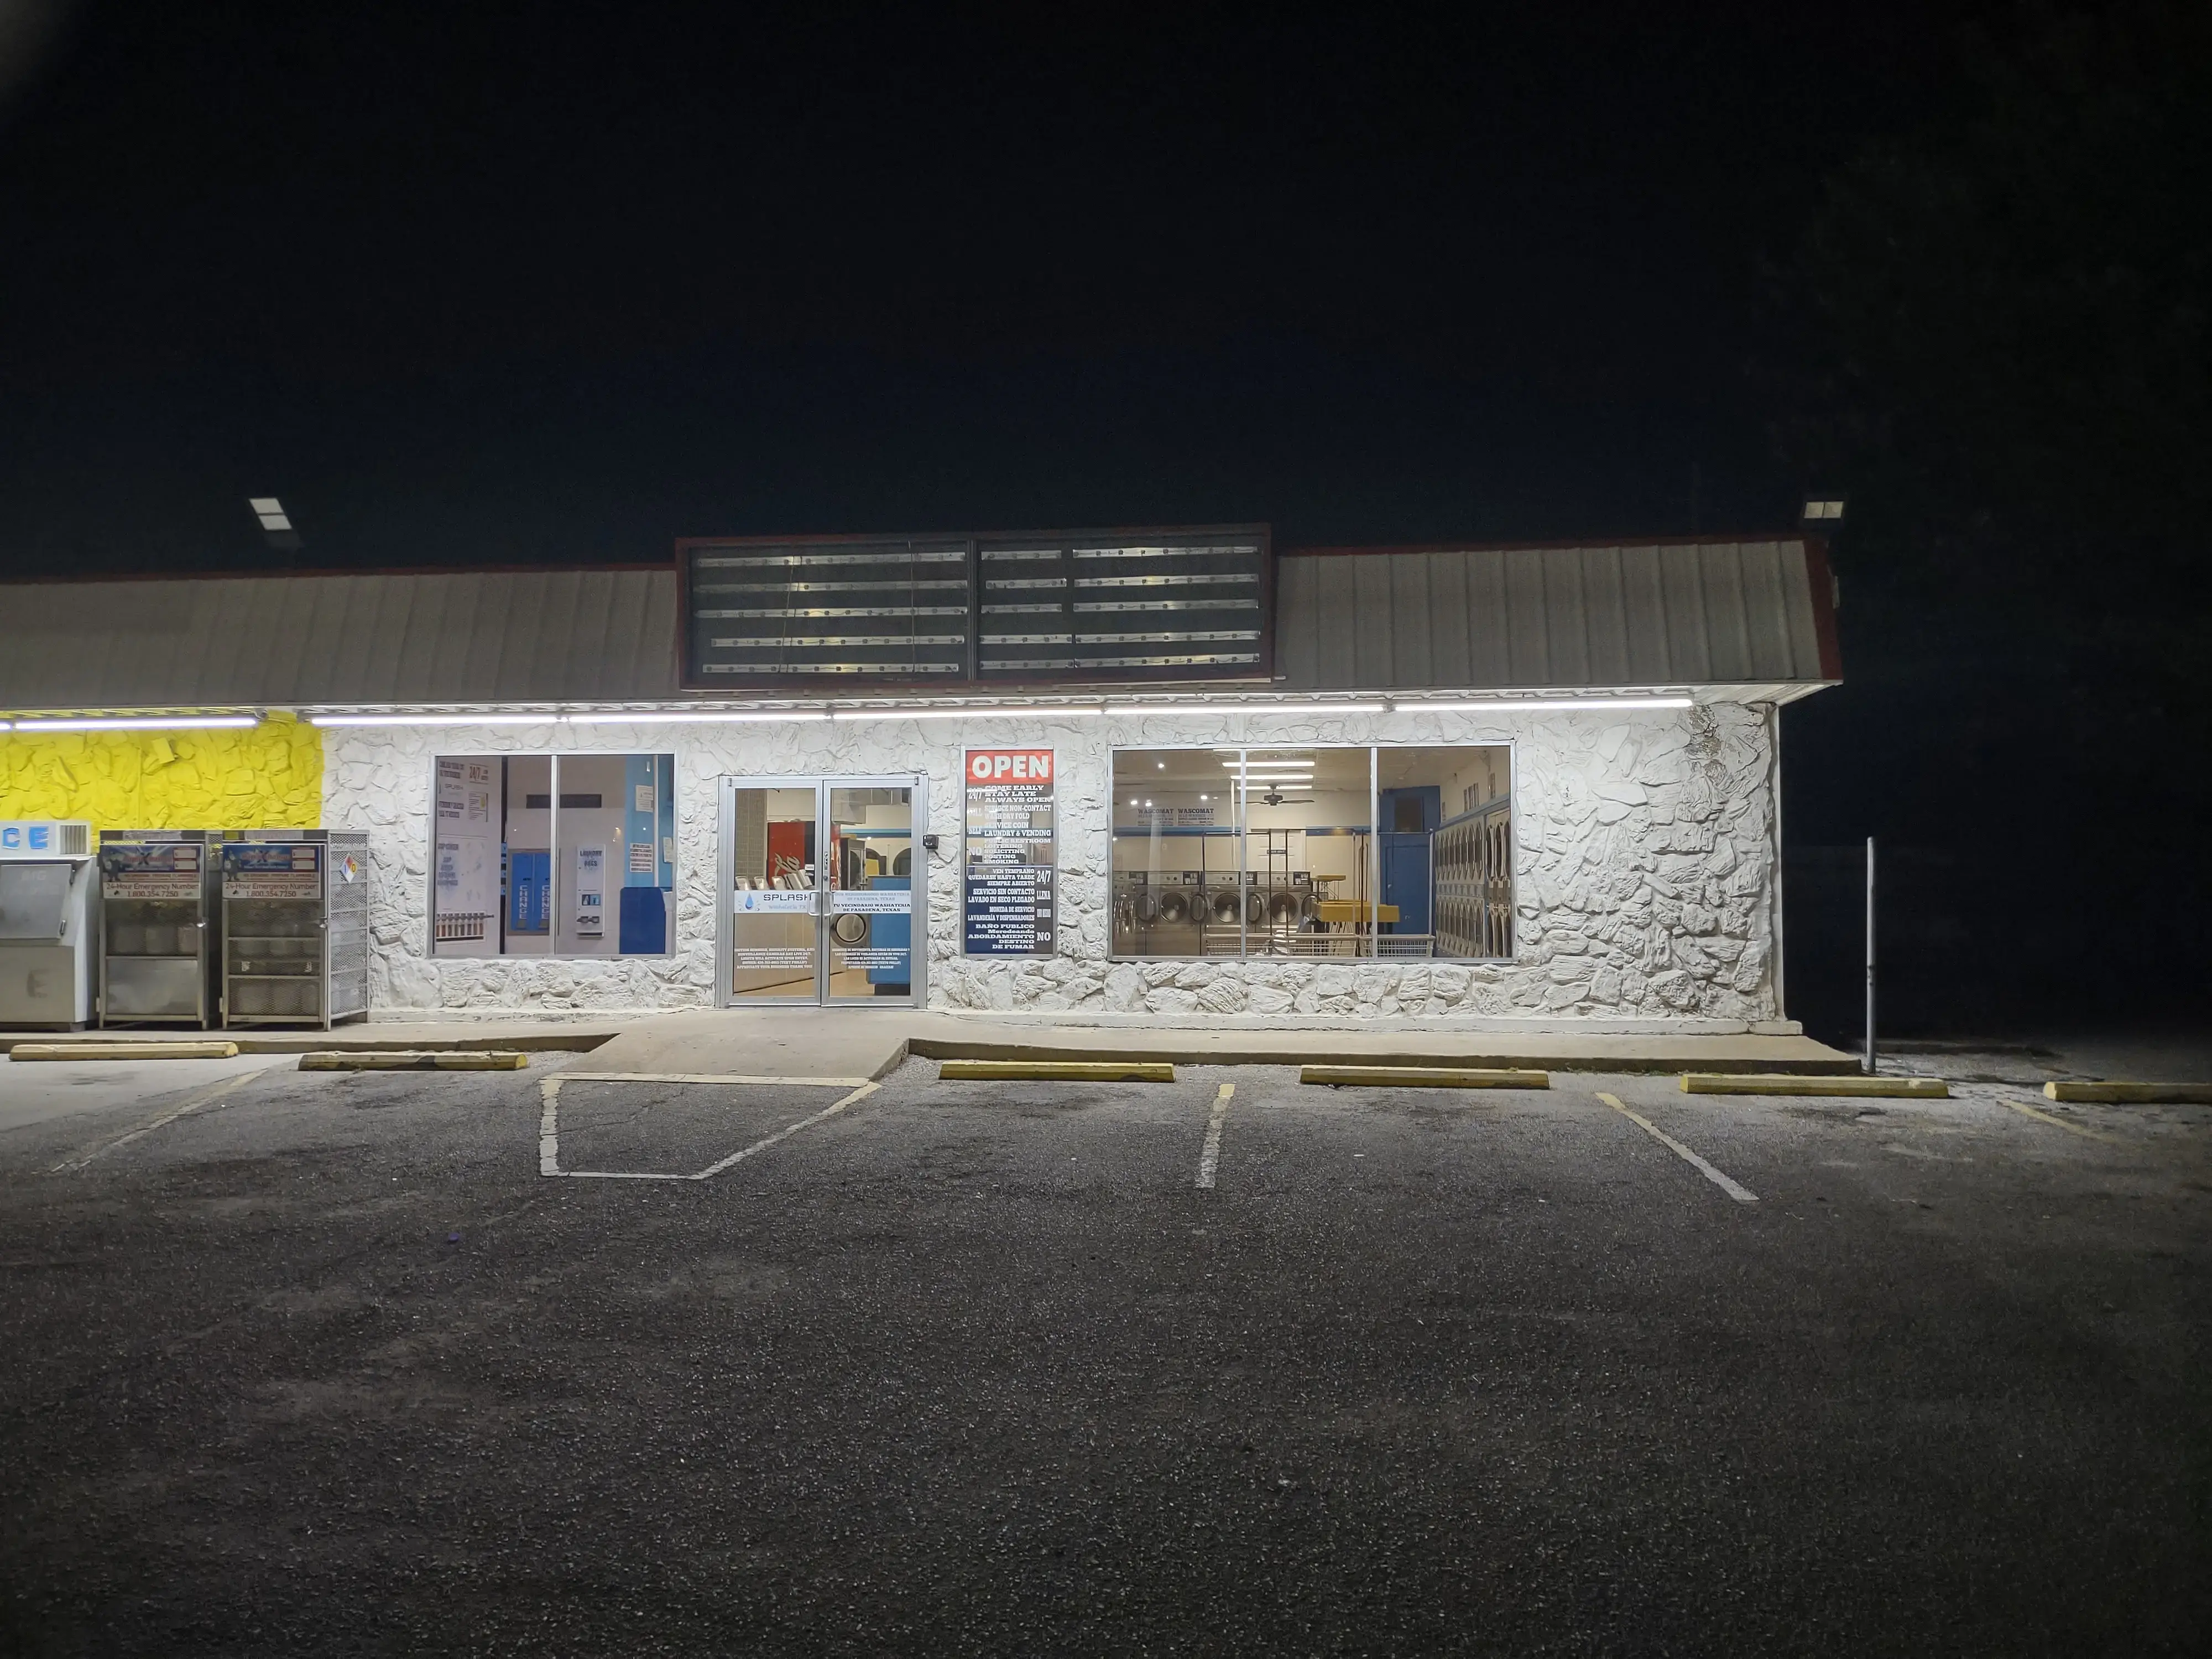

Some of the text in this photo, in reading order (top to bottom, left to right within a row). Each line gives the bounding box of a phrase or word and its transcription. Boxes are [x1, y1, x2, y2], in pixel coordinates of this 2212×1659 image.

[972, 755, 1048, 778] OPEN
[469, 766, 481, 781] 24/7
[969, 788, 982, 801] 24/7
[969, 847, 982, 855] NO
[1037, 870, 1051, 884] 24/7
[1037, 932, 1051, 941] NO
